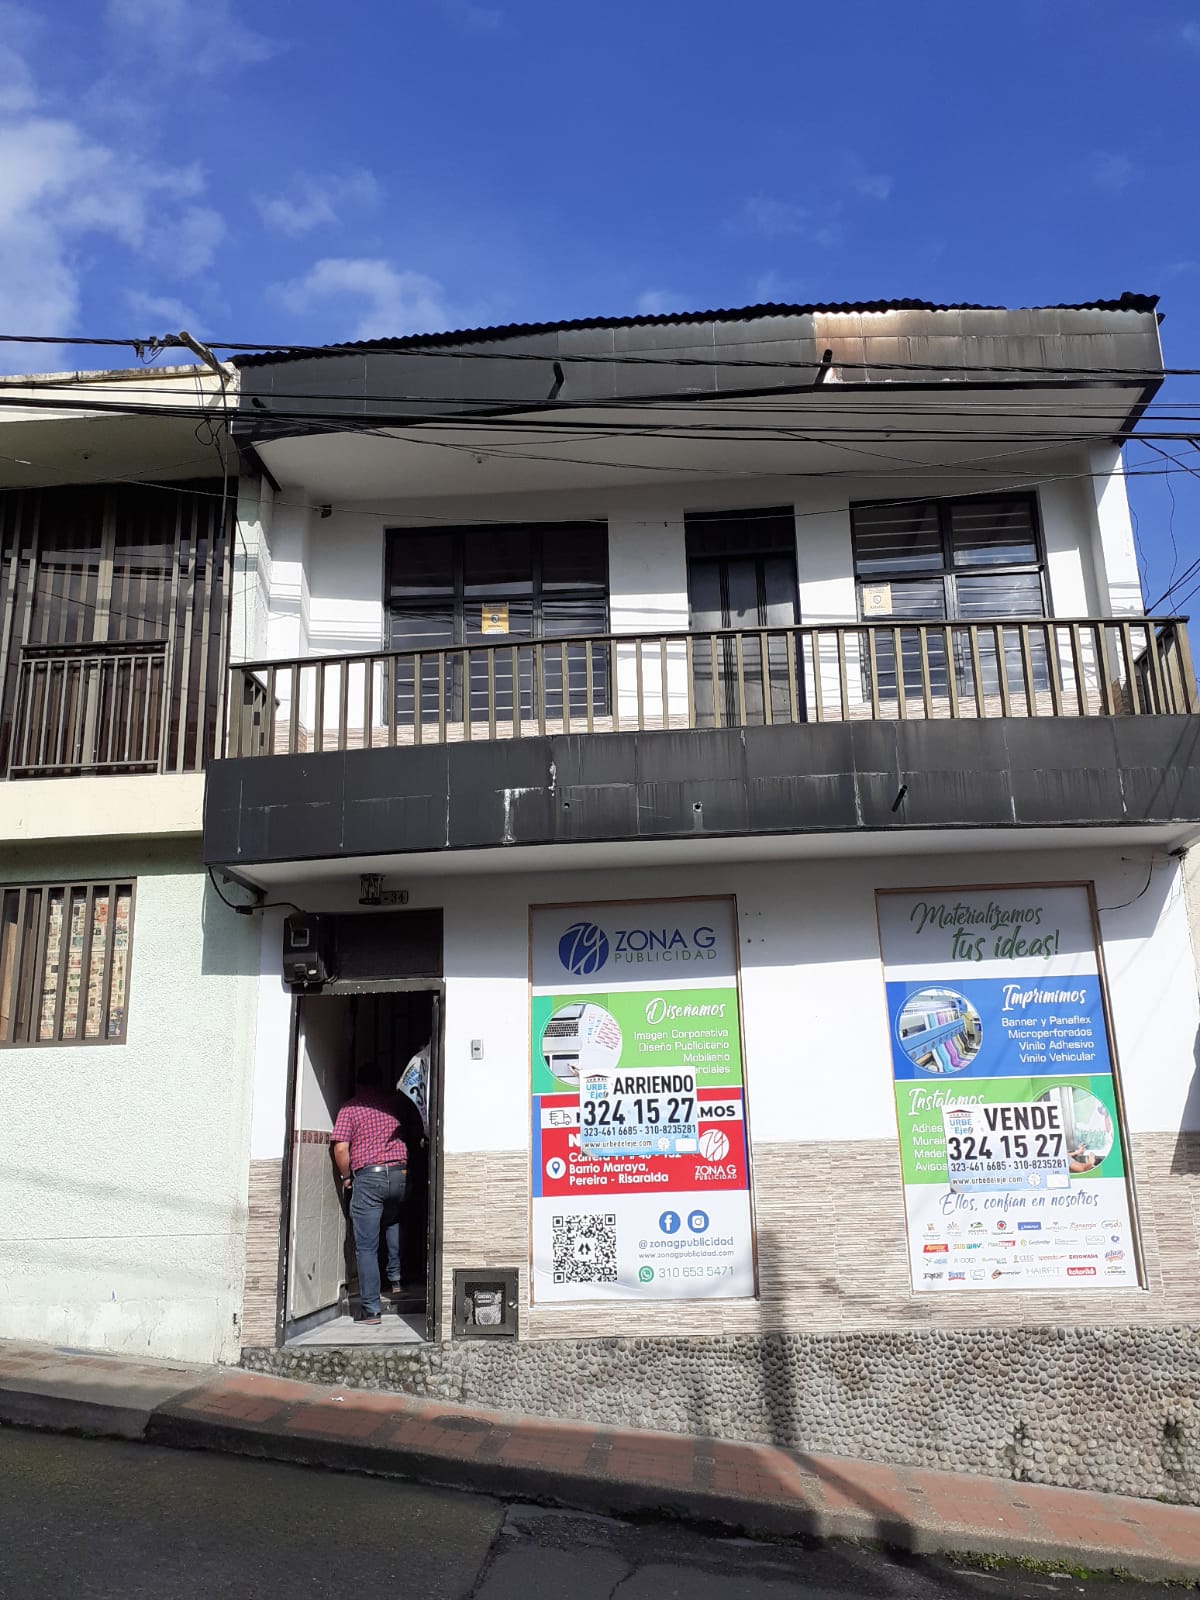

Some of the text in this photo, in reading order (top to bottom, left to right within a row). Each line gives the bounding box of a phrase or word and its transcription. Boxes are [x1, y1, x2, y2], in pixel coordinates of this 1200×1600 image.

[910, 902, 1043, 934] Materializamos
[615, 926, 716, 951] ZONA G
[952, 925, 1060, 961] tus ideas!
[614, 949, 717, 963] PUBLICIDAD
[1002, 984, 1087, 1011] Imprimimos
[646, 997, 727, 1025] Diseñamos
[1002, 1015, 1092, 1027] Banner y Panaflex
[633, 1029, 729, 1041] Imagen Corporativa
[1008, 1028, 1093, 1040] Microperforados
[639, 1040, 730, 1052] Diseño Publicitario
[1019, 1040, 1095, 1050] Vinilo Adhesivo
[683, 1053, 730, 1063] Mobiliario
[1019, 1052, 1096, 1063] Vinilo Vehicular
[586, 1083, 608, 1091] URBE
[613, 1075, 694, 1095] ARRIENDO
[583, 1100, 626, 1126] 324
[633, 1098, 660, 1124] 15
[667, 1097, 694, 1123] 27
[949, 1119, 973, 1127] URBE
[984, 1105, 1061, 1132] VENDE
[583, 1127, 616, 1137] 323-461
[618, 1126, 638, 1136] 6685
[645, 1124, 696, 1135] 310-8235281
[912, 1123, 944, 1133] Adhes
[948, 1133, 1063, 1161] 324 15 27
[569, 1163, 649, 1174] Barrio Maraya,
[695, 1164, 737, 1176] ZONA G
[951, 1161, 984, 1172] 323-461
[986, 1160, 1007, 1171] 6685
[1014, 1159, 1067, 1170] 310-8235281
[569, 1175, 608, 1186] Pereira
[618, 1172, 669, 1184] Risaralda
[939, 1192, 978, 1216] Ellos,
[1031, 1196, 1046, 1208] en
[1051, 1189, 1099, 1208] nosotros
[659, 1265, 734, 1278] 310 653 5471
